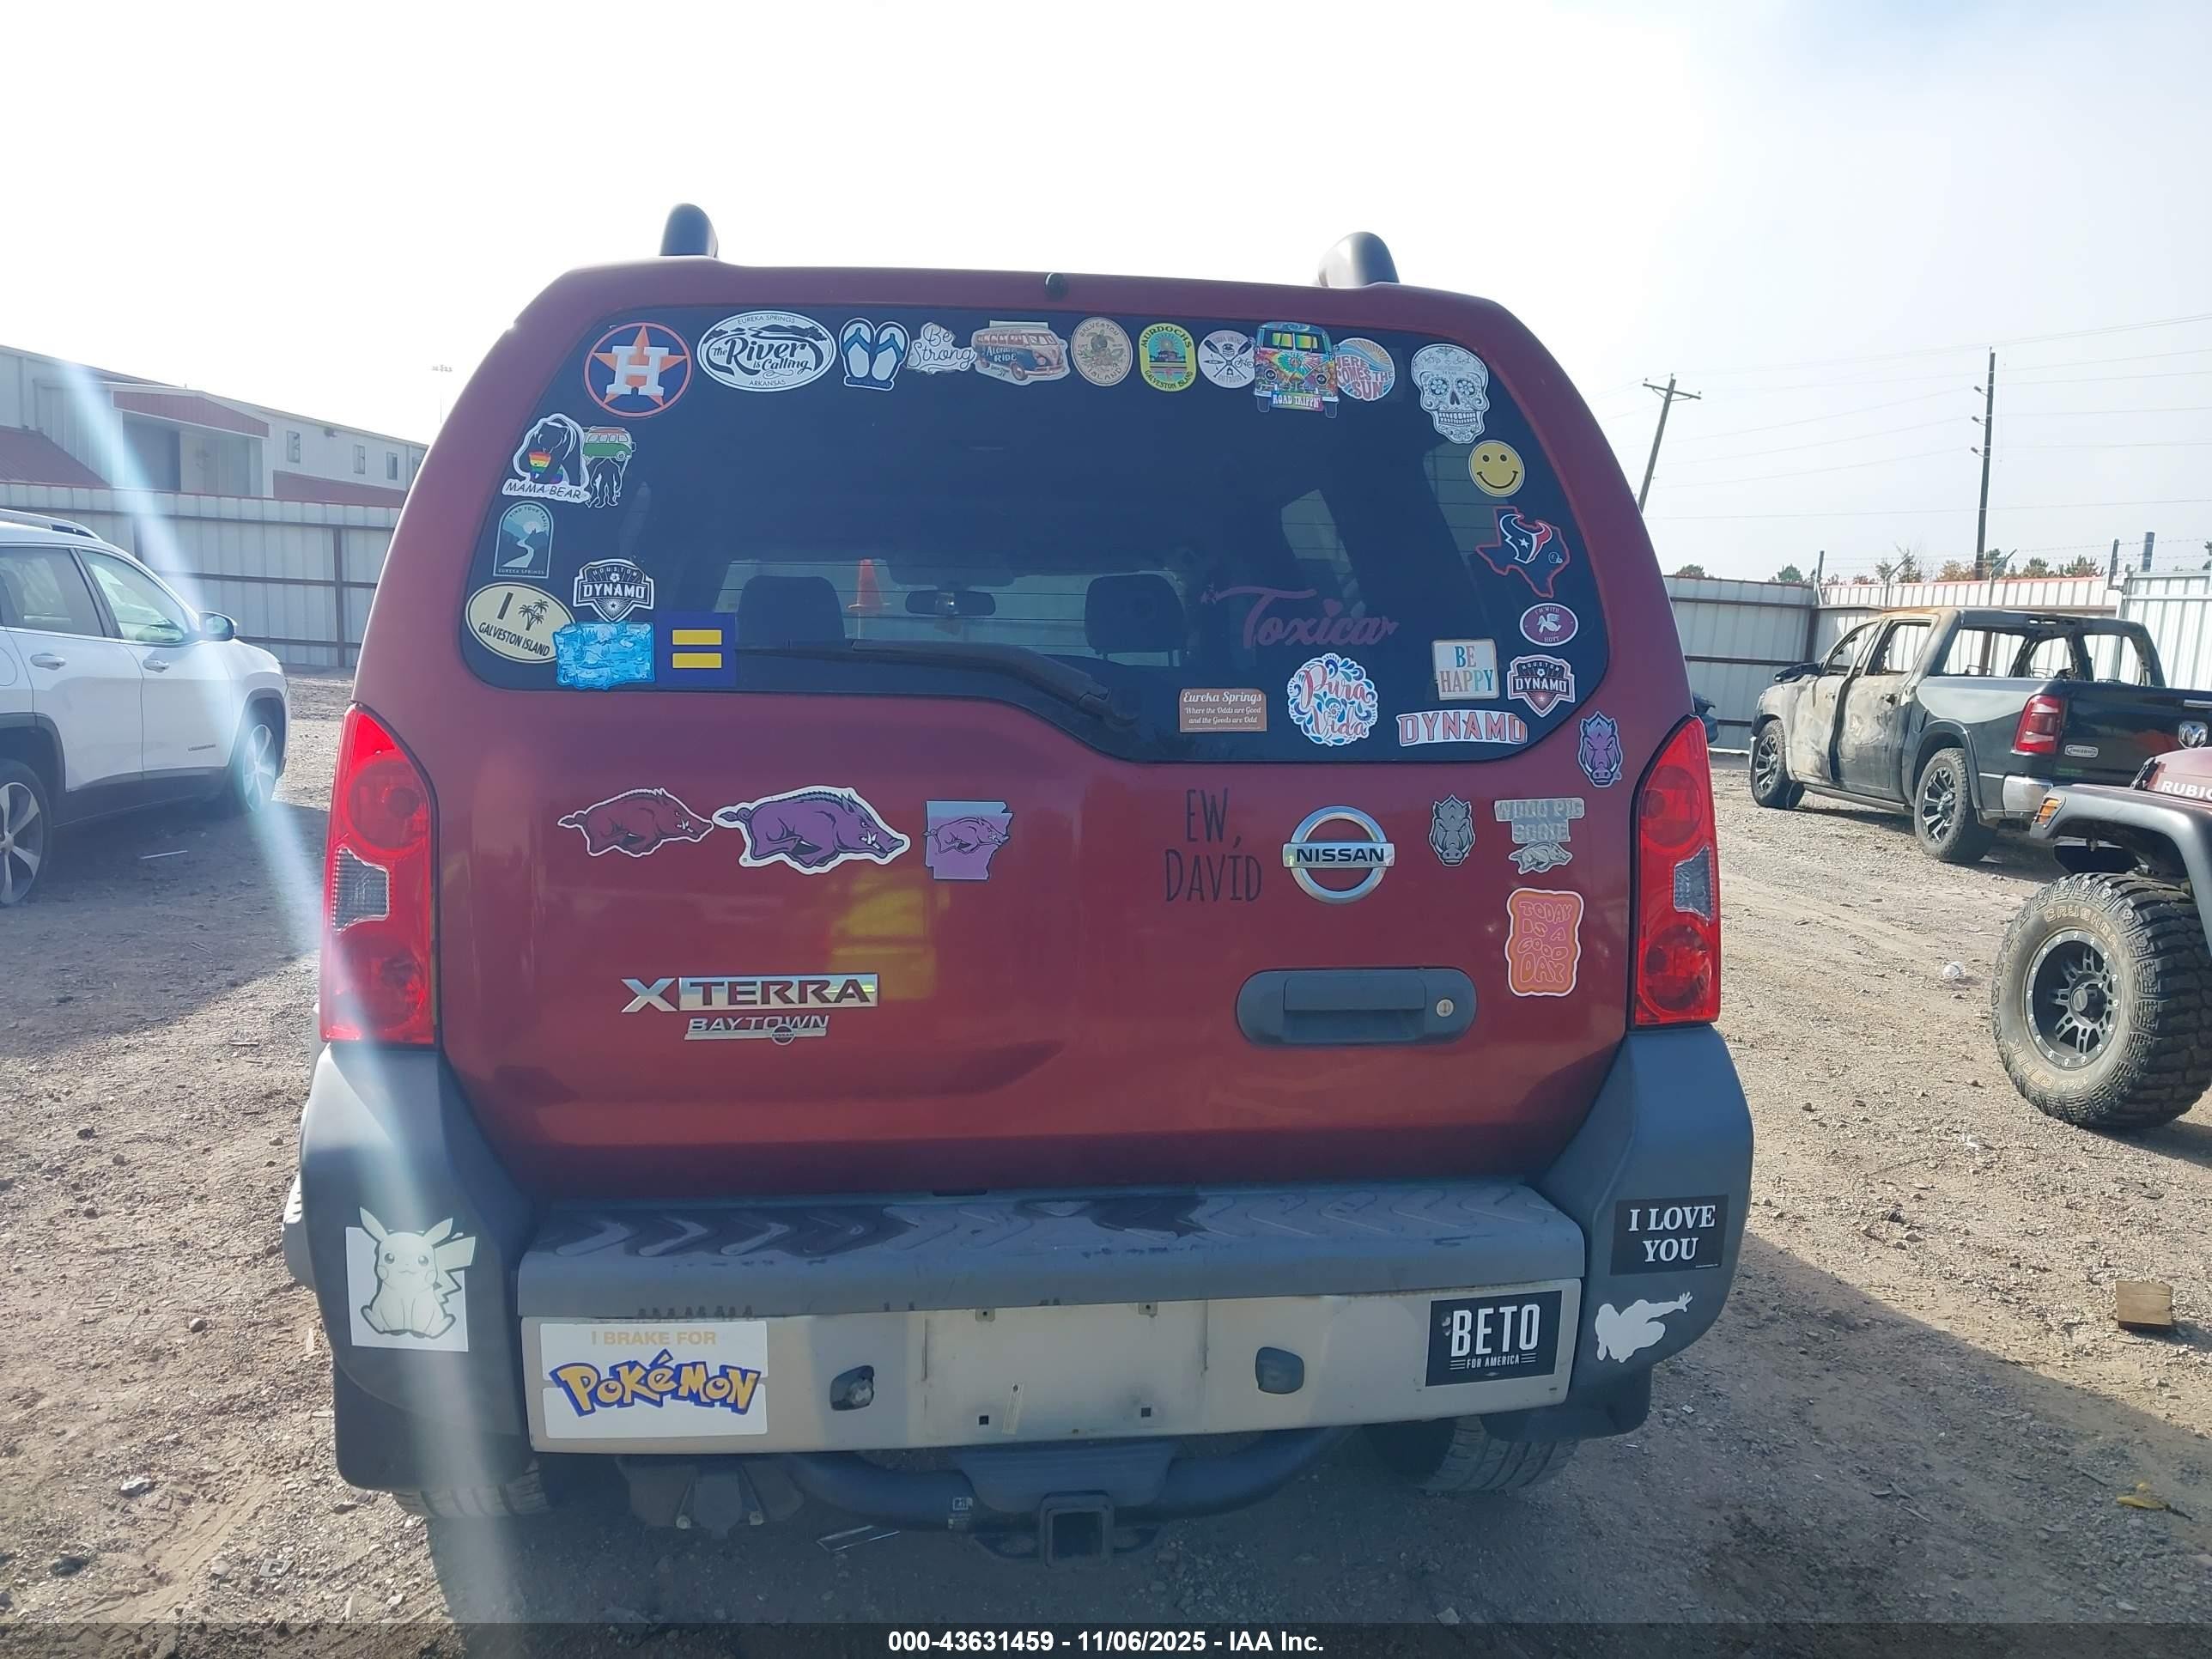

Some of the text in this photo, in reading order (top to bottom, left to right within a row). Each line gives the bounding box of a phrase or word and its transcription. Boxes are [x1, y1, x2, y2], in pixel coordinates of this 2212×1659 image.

[737, 314, 795, 325] EUREKA SPRINGS
[923, 323, 952, 347] Be
[1140, 326, 1192, 348] MURDOCHS
[725, 337, 807, 375] River
[762, 356, 812, 374] Calling
[908, 342, 975, 369] Strong
[994, 353, 1018, 362] RIDE
[605, 345, 670, 396] H
[1336, 367, 1393, 387] COMES THE
[1273, 393, 1292, 404] ROAD
[1351, 381, 1384, 399] SUN
[505, 482, 581, 499] MAMA BEAR
[592, 567, 637, 576] HOUSTON
[582, 583, 647, 599] DYNAMO
[497, 592, 514, 620] I
[1215, 586, 1398, 649] Toxica
[478, 622, 550, 657] GALVESTON ISLAND
[1455, 646, 1477, 668] BE
[1521, 661, 1560, 672] HOUSTON
[1300, 664, 1368, 709] Pura
[1438, 669, 1494, 693] HAPPY
[1515, 677, 1567, 693] DYNAMO
[1183, 690, 1262, 705] Eureka Springs
[1212, 716, 1231, 725] Goods
[1245, 706, 1261, 714] Good
[1310, 705, 1367, 736] Vida
[1399, 713, 1525, 744] DYNAMO
[1186, 787, 1241, 848] EW,
[1296, 848, 1384, 863] NISSAN
[1164, 849, 1262, 902] DAVID
[1518, 901, 1572, 924] TODAY
[1522, 918, 1566, 941] IS A
[1517, 937, 1569, 961] GOOD
[1521, 951, 1565, 983] DAY
[688, 1014, 830, 1033] BAYTOWN
[1628, 1204, 1716, 1231] I LOVE
[1642, 1237, 1699, 1263] YOU
[591, 1331, 717, 1346] I BRAKE FOR
[1450, 1304, 1540, 1357] BETO
[1466, 1354, 1519, 1369] FOR AMERICA
